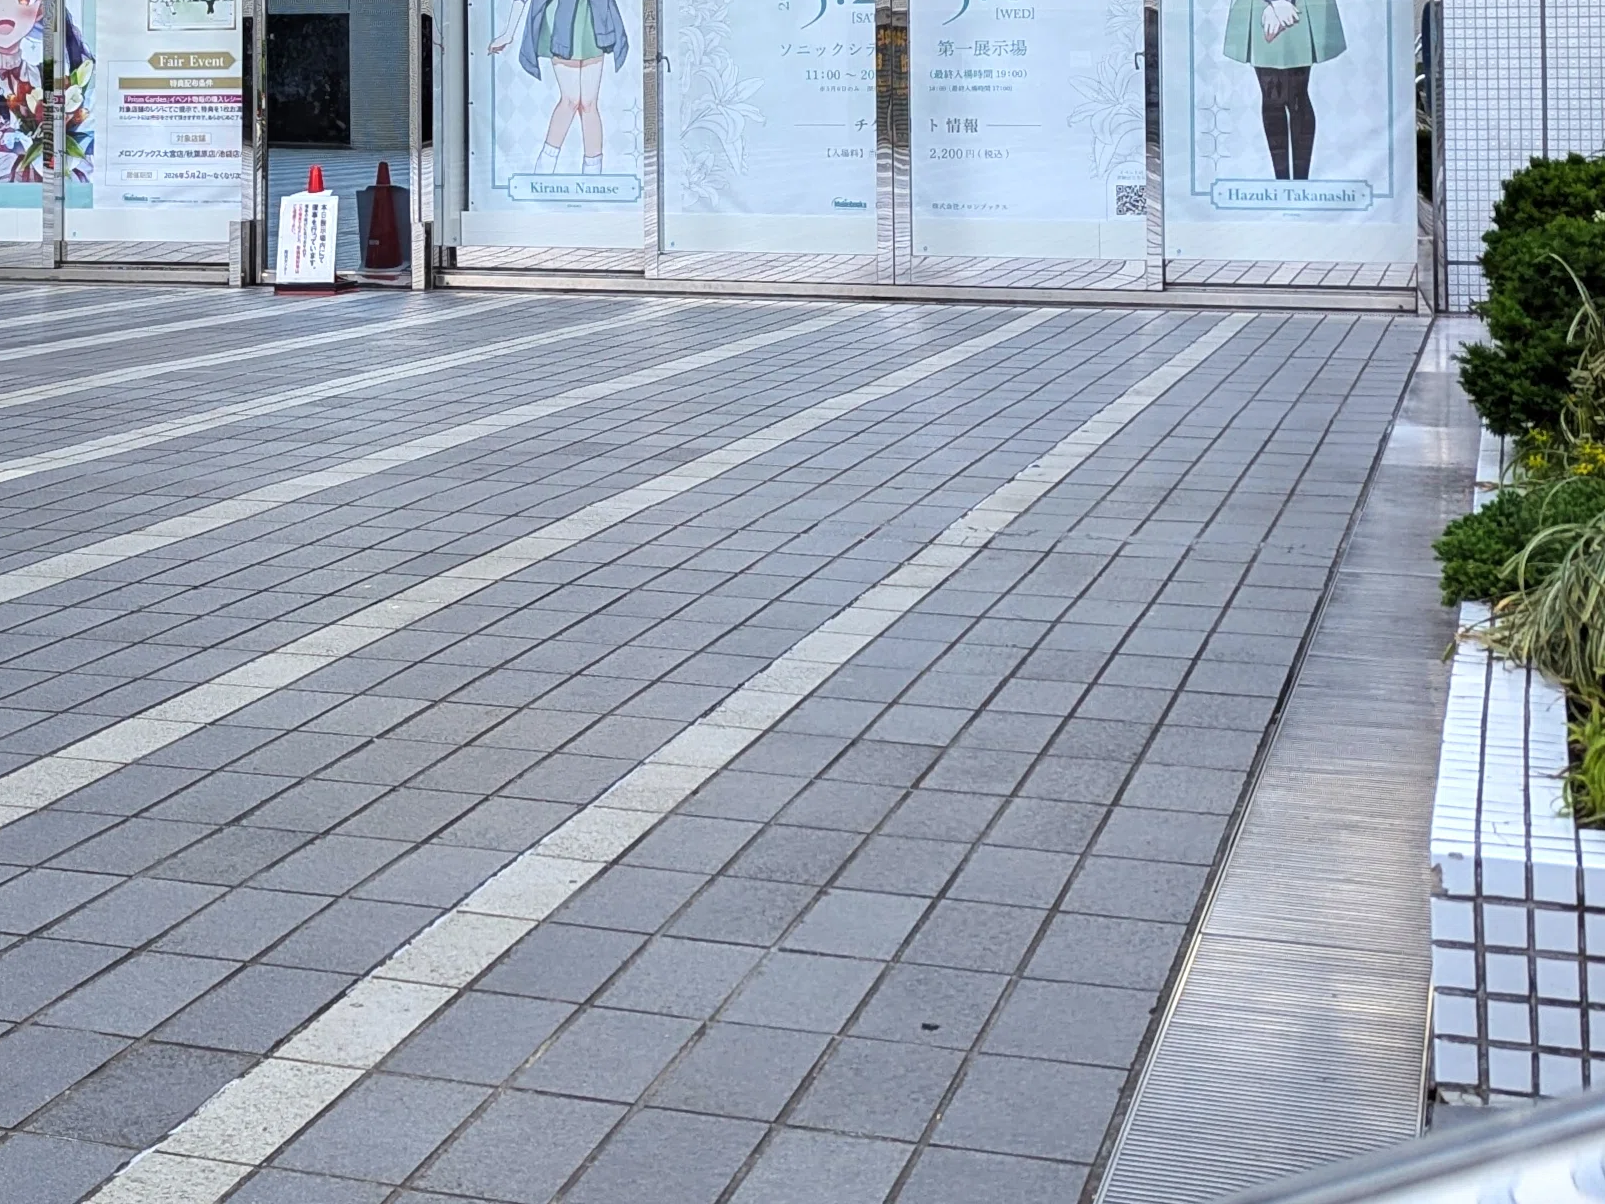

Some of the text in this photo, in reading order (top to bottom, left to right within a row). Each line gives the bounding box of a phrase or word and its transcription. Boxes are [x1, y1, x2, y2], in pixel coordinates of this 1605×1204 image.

[937, 39, 1028, 56] 第一展示場
[159, 54, 225, 68] Fair Event
[805, 69, 841, 81] 11:00
[530, 181, 620, 195] Kirana Nanase
[1228, 188, 1356, 202] Hazuki Takanashi
